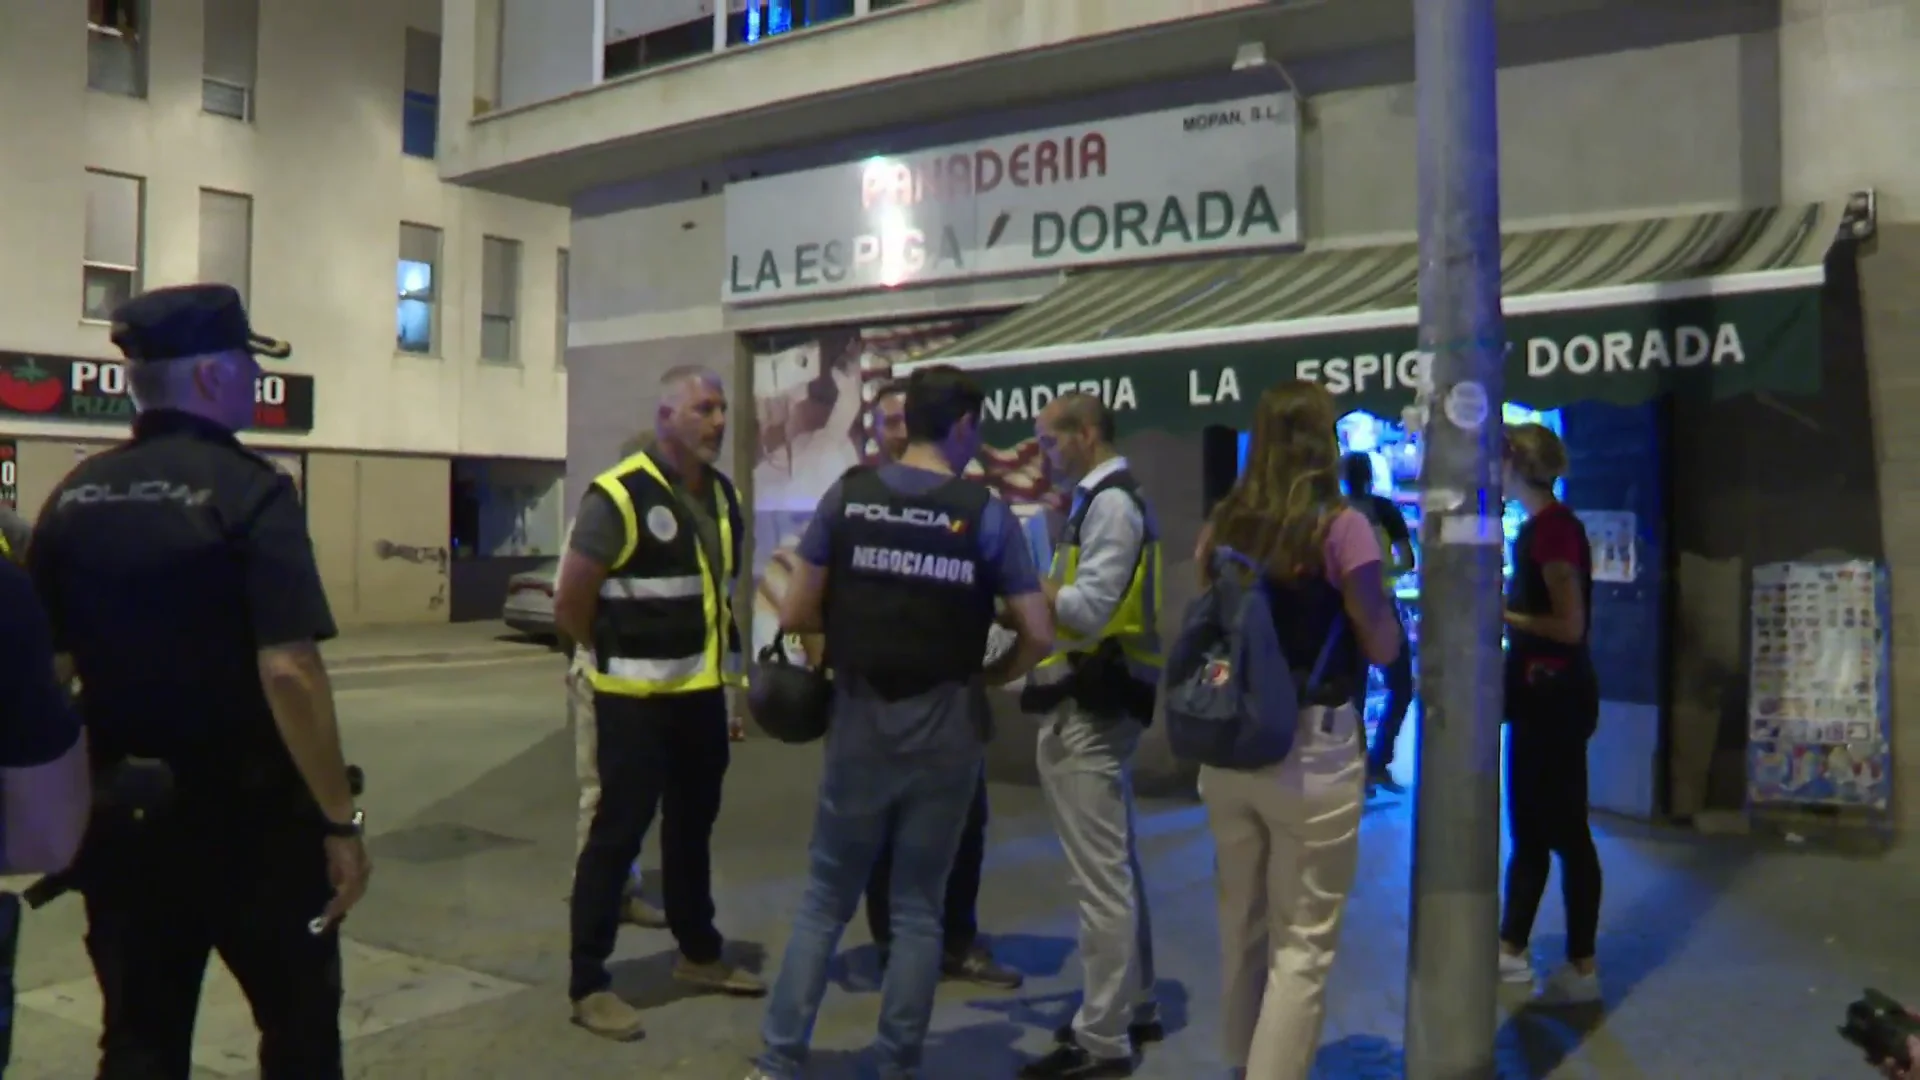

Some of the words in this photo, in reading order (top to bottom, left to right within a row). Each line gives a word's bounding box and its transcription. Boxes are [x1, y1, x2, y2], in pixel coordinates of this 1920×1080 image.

[731, 248, 782, 293] LA
[795, 222, 963, 286] ESPGA
[1032, 184, 1281, 258] DORADA
[1188, 366, 1241, 406] LA
[1295, 350, 1428, 395] ESPIG
[1527, 322, 1745, 378] DORADA
[844, 502, 951, 530] POLICIA
[852, 545, 975, 584] NEGOCIADOR
